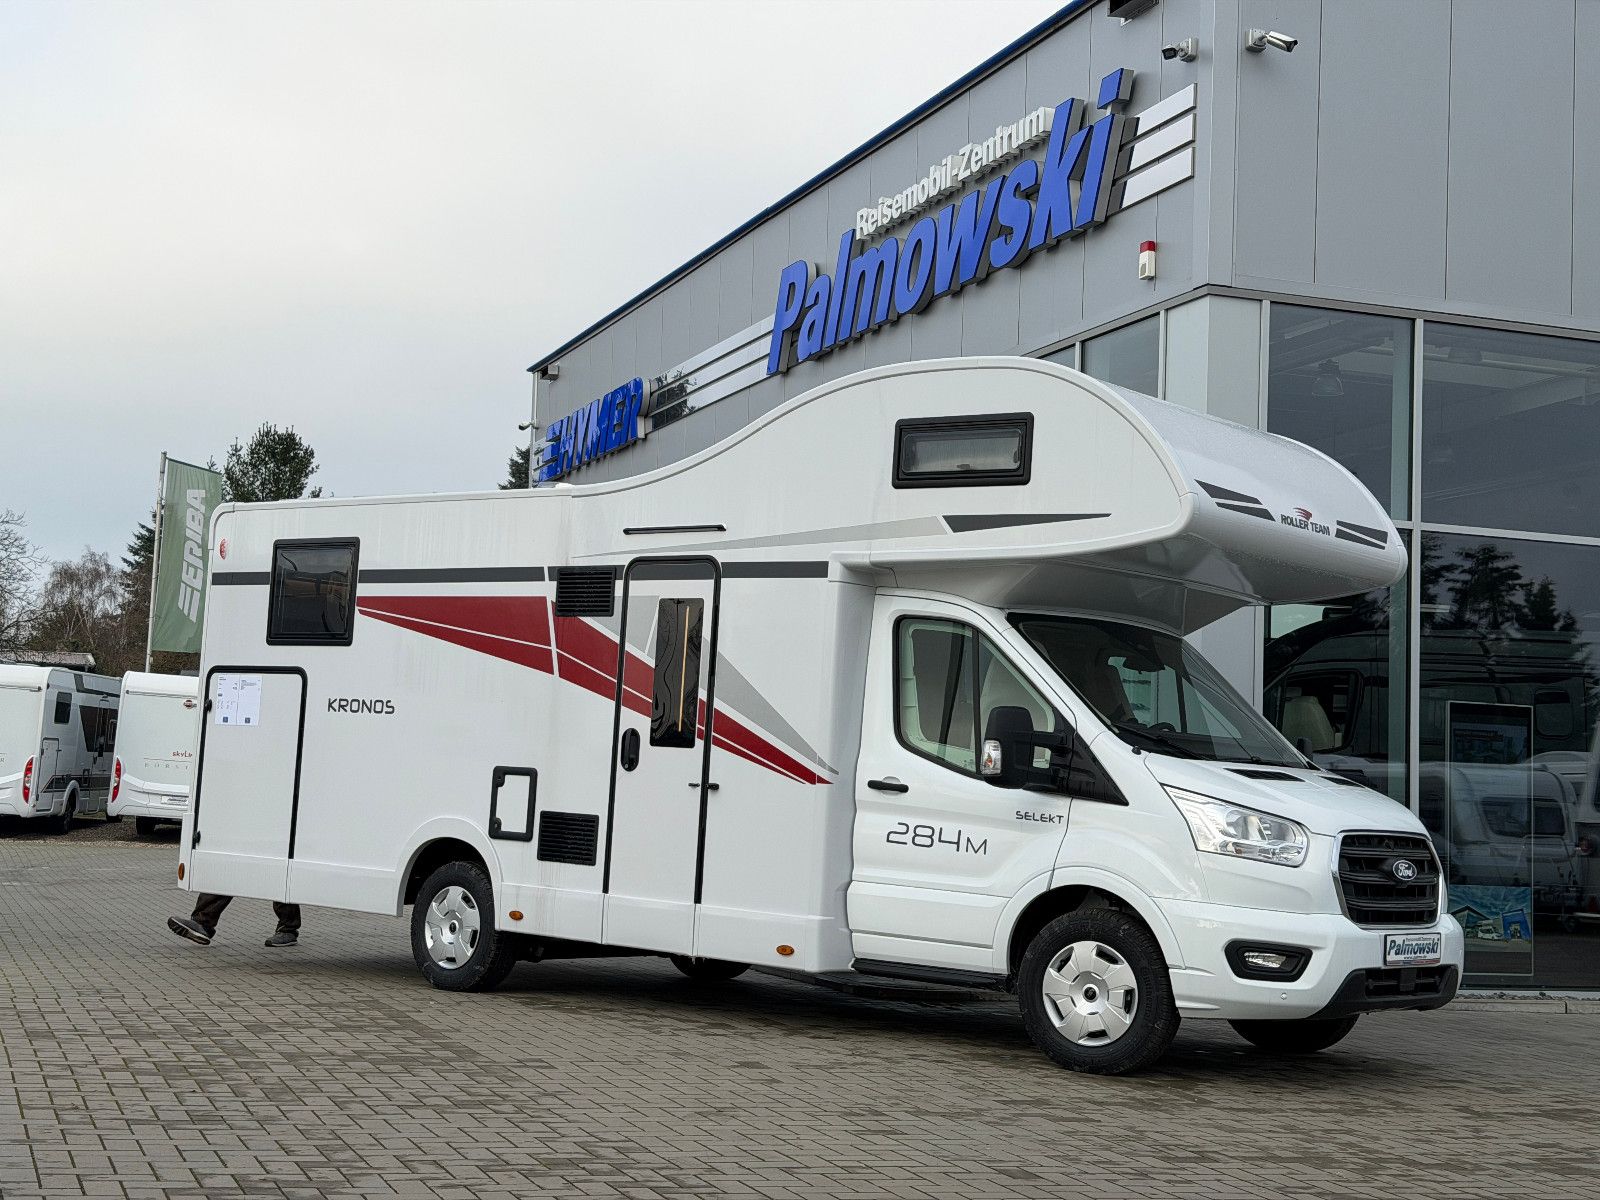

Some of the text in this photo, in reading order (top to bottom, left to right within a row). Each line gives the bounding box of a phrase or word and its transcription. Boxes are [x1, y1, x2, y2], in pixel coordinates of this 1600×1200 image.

[856, 107, 1056, 241] Reisemobil-Zentrum
[767, 68, 1132, 375] Palmowski
[557, 376, 647, 476] HYMER
[181, 489, 206, 595] ERIBA
[1280, 513, 1330, 536] ROLLER TEAM
[327, 697, 395, 714] KRONOS
[1015, 810, 1064, 825] SELEKT
[1387, 937, 1439, 956] Palmowski
